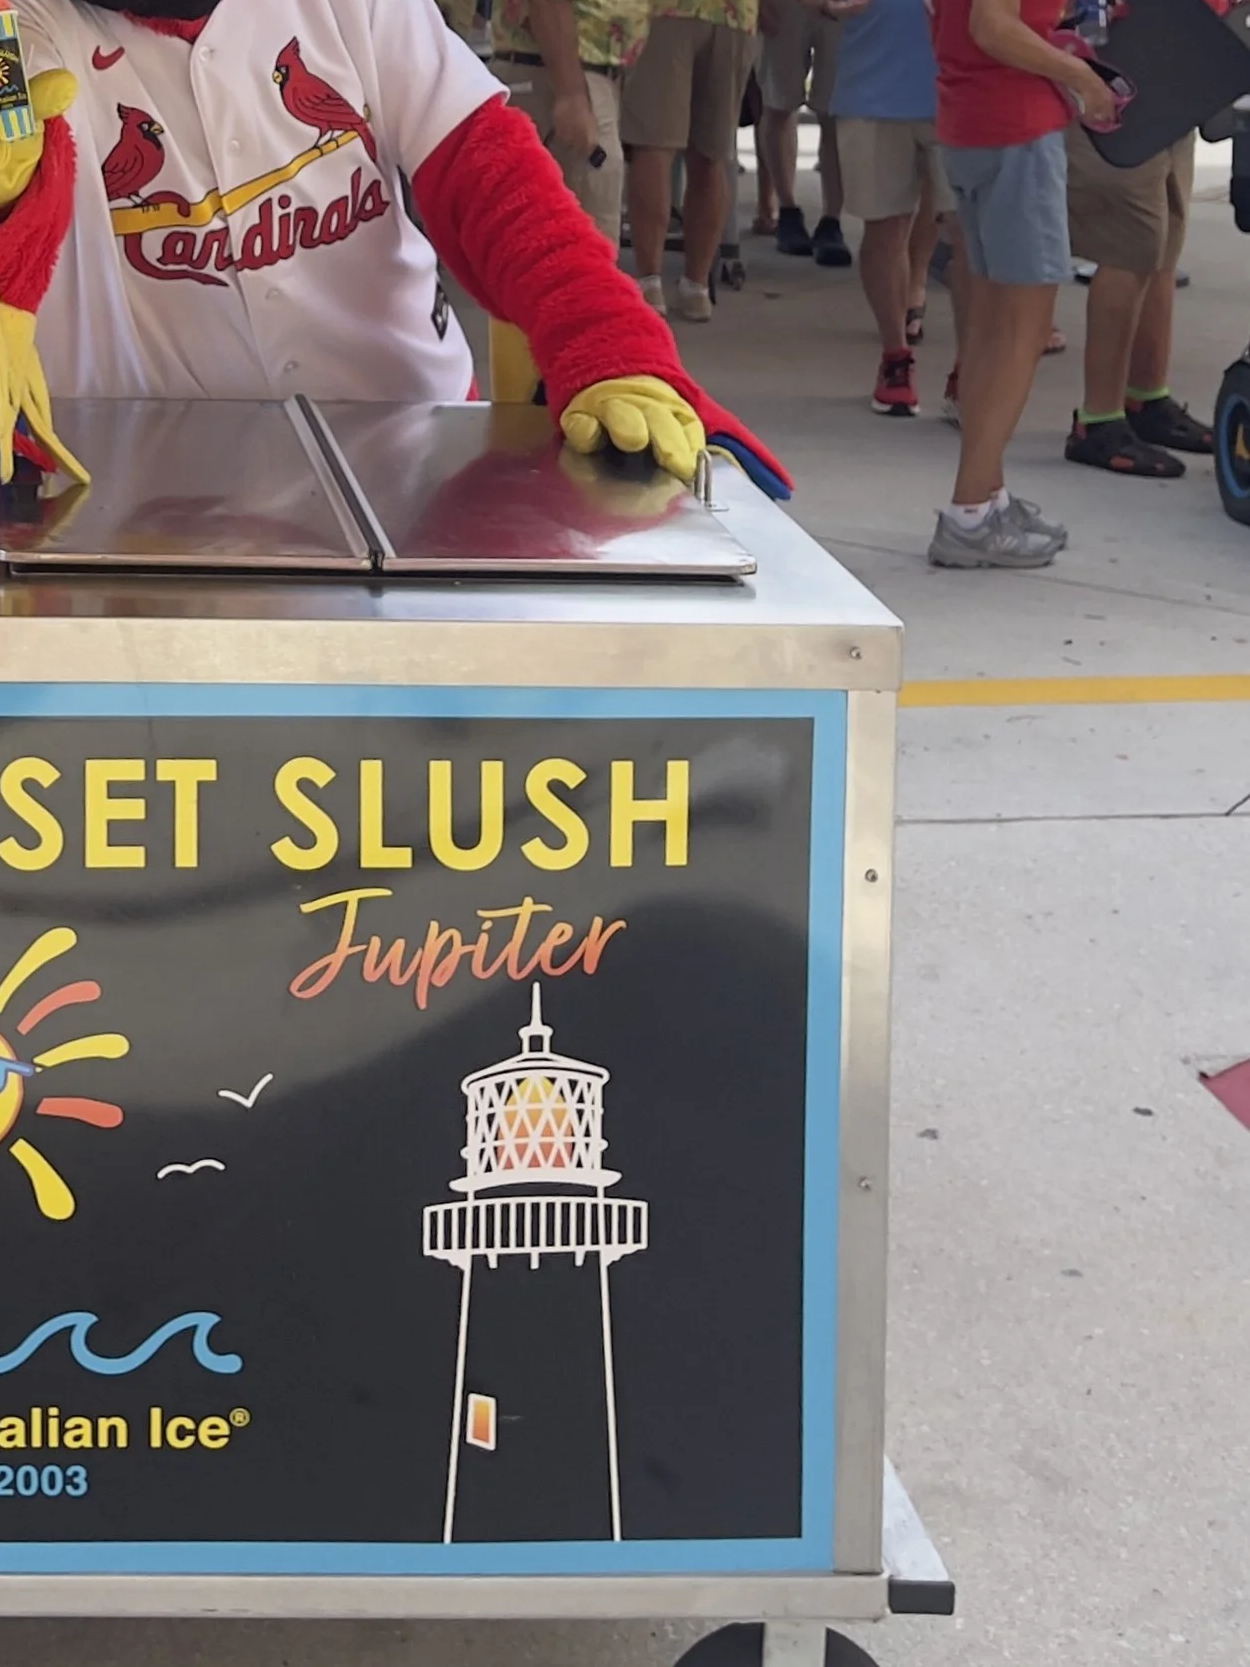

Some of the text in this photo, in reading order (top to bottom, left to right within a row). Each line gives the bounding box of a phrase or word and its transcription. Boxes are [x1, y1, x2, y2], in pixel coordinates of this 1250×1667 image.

[124, 166, 390, 287] Cardinals
[269, 755, 691, 872] SLUSH
[288, 887, 627, 1011] Jupiter
